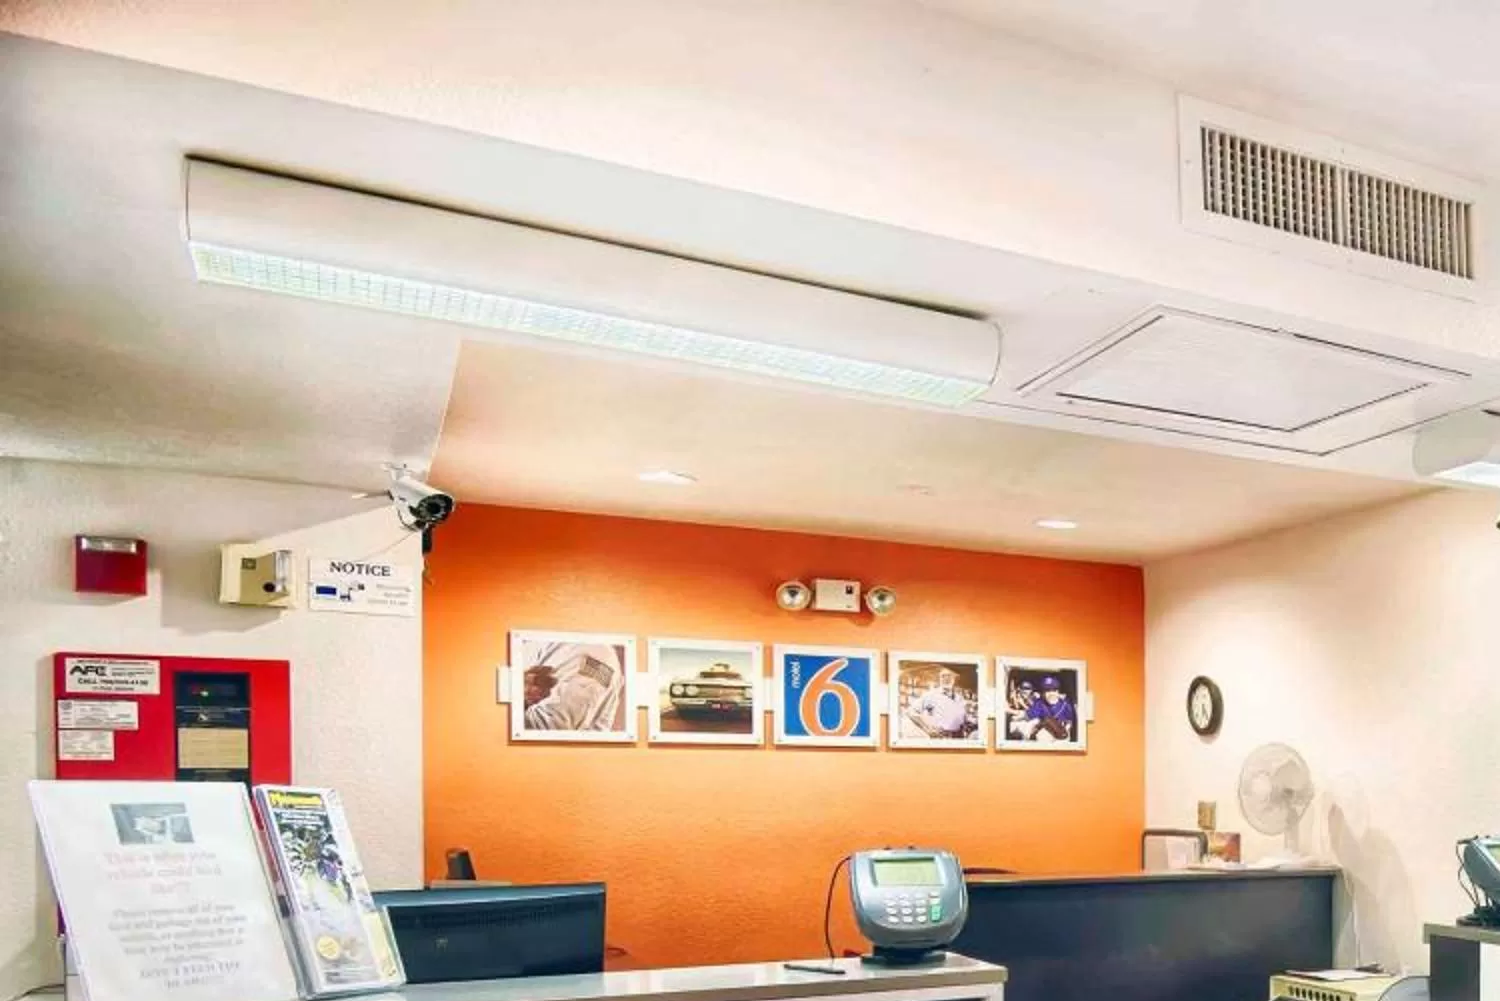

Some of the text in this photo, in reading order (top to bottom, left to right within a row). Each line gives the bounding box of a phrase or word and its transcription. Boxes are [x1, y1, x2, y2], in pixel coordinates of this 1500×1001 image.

[329, 561, 392, 577] NOTICE
[790, 657, 860, 736] motel 6
